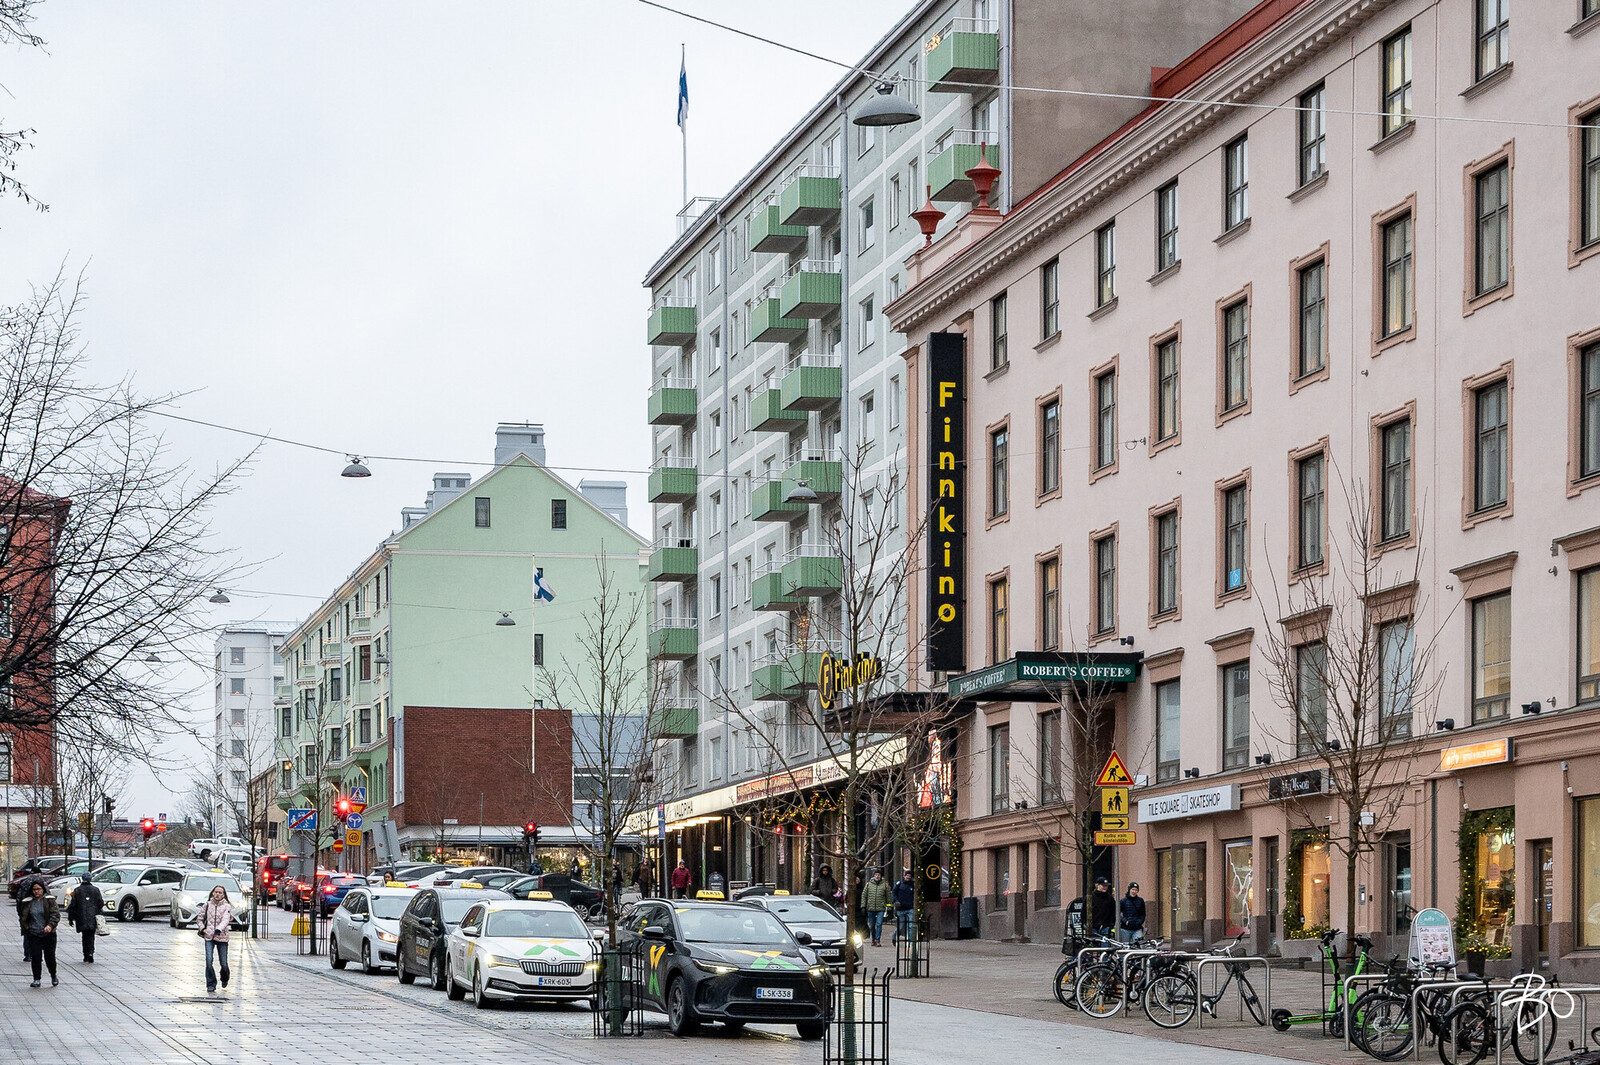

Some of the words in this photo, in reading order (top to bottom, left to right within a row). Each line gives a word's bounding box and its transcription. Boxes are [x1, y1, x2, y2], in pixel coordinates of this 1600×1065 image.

[938, 381, 956, 623] Finnkino
[1023, 665, 1077, 677] ROBERT'S
[1148, 801, 1159, 817] TILE
[1159, 798, 1180, 815] SQUARE
[1189, 791, 1221, 810] SKATESHOP
[762, 989, 792, 998] LSK-338
